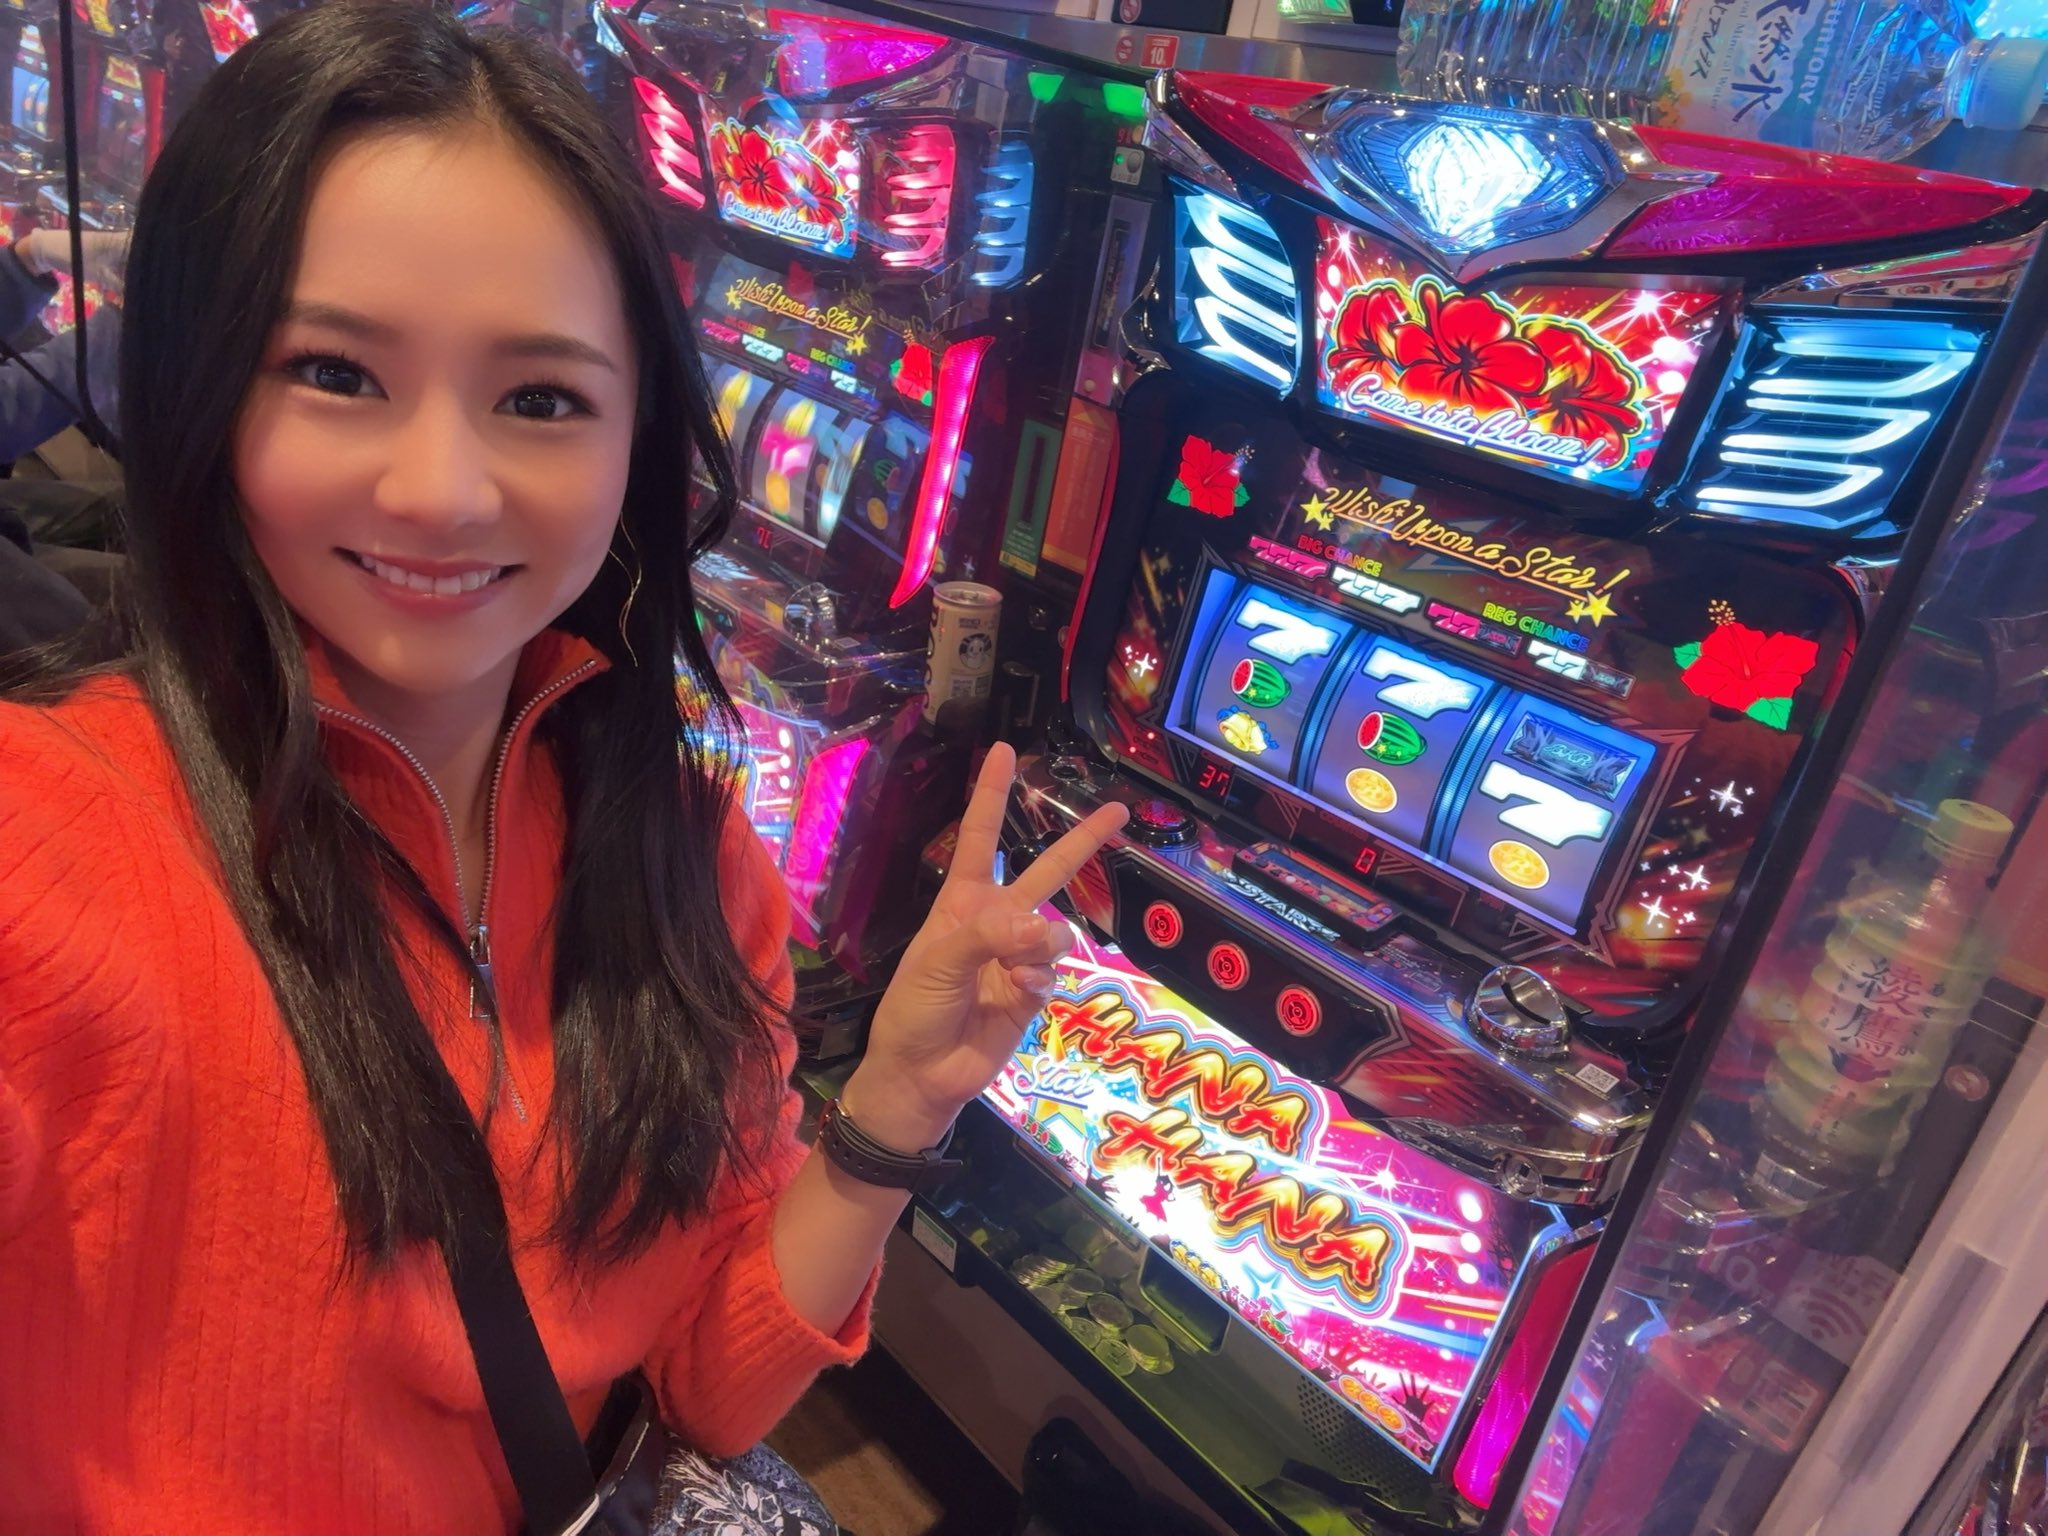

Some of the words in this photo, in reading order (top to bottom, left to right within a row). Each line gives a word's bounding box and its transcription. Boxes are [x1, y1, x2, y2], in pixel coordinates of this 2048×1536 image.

[736, 277, 778, 302] Wish
[766, 286, 806, 315] Upon
[1346, 372, 1423, 415] Come
[1420, 400, 1481, 434] into
[1466, 408, 1606, 465] Bloom!
[1297, 534, 1324, 555] BIG
[1323, 545, 1384, 578] CHANCE
[1323, 486, 1410, 526] Wish
[1391, 503, 1476, 548] Upon
[1473, 542, 1507, 560] a
[1493, 546, 1631, 596] Star!
[1482, 602, 1518, 627] REG
[1518, 615, 1591, 654] CHANCE
[1542, 743, 1593, 767] BAR
[1199, 764, 1230, 797] 37
[1355, 846, 1377, 874] 0
[1835, 956, 1924, 1059] 綾鷹
[1013, 1053, 1095, 1098] Star
[1041, 992, 1306, 1153] HANA
[1102, 1108, 1390, 1287] HANA
